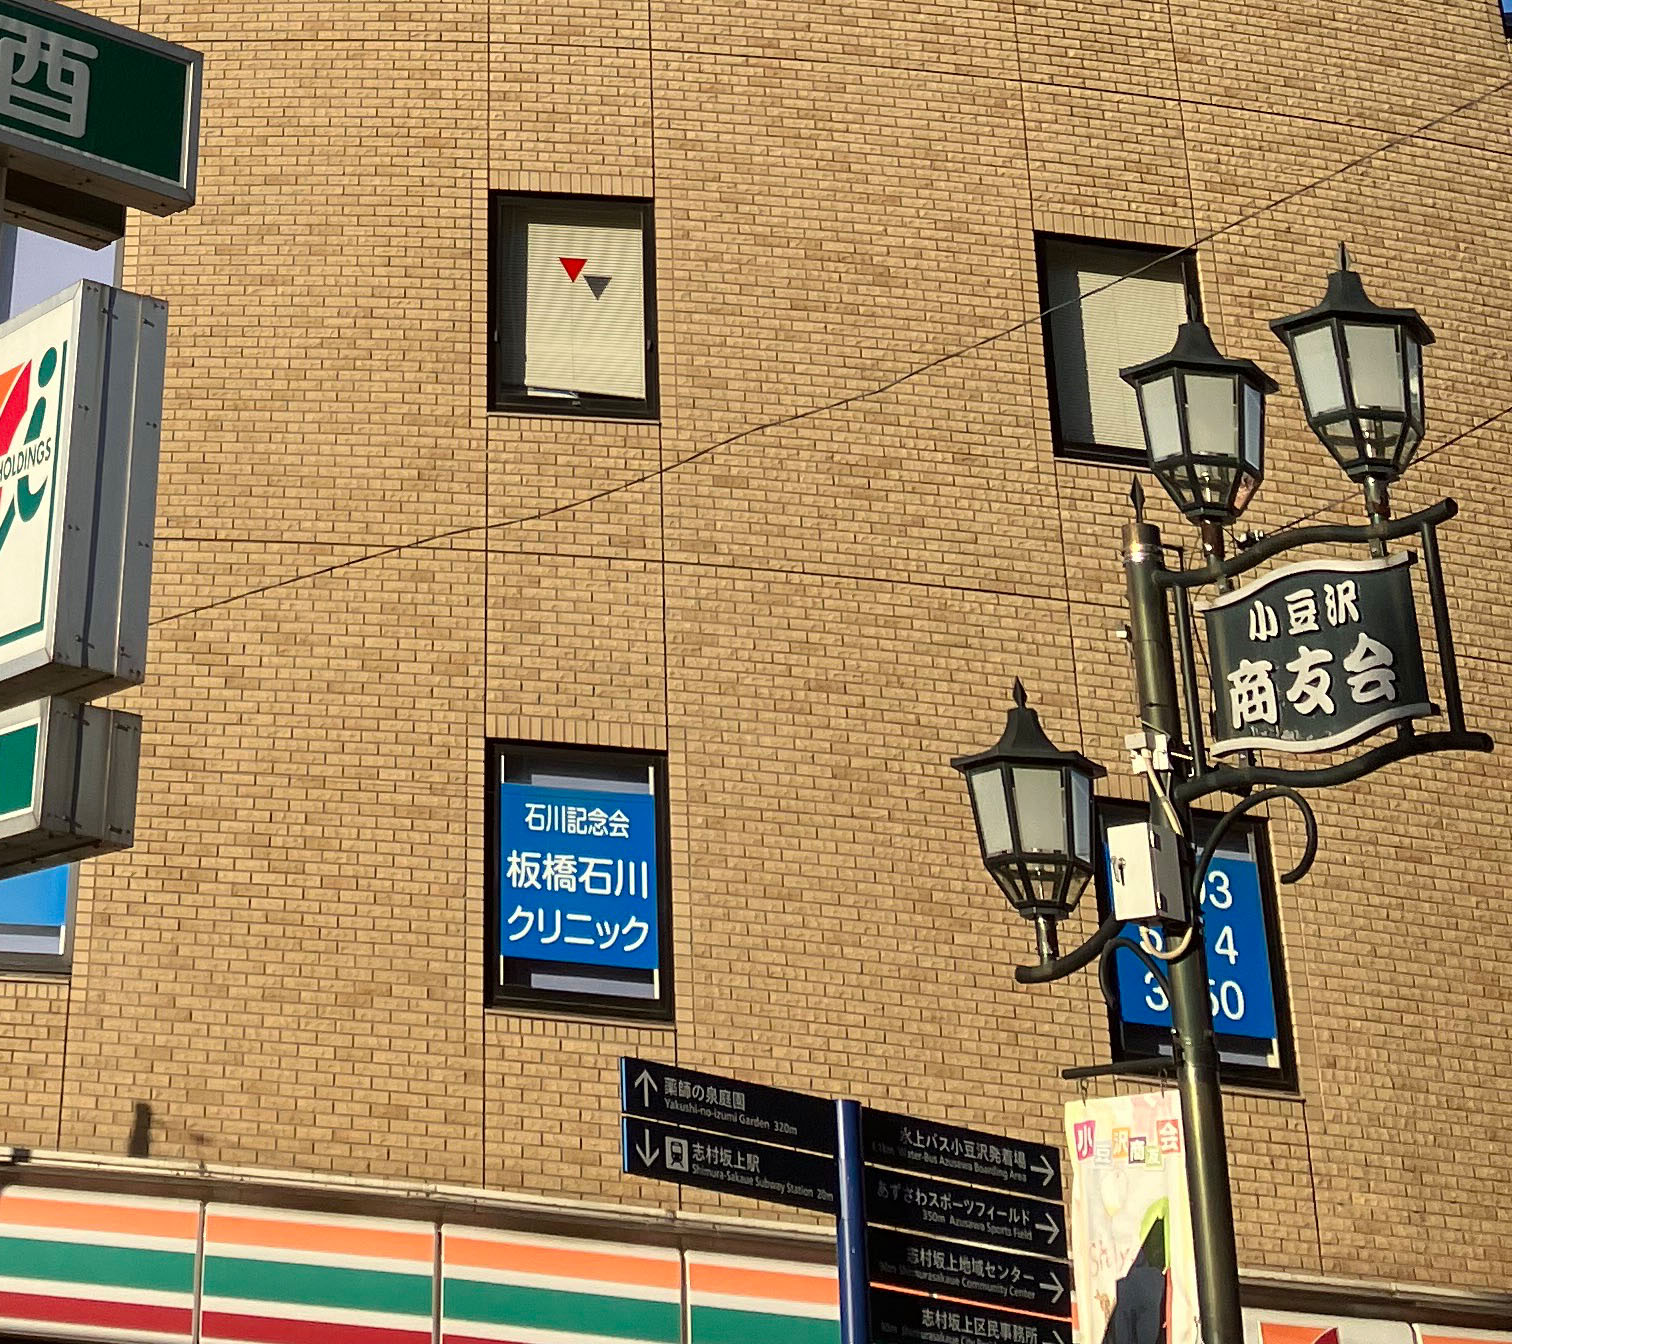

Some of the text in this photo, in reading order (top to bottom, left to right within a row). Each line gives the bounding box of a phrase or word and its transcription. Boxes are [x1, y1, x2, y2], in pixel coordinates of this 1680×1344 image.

[1249, 580, 1359, 641] 小豆沢
[1227, 632, 1396, 729] 商友会
[524, 803, 630, 838] 石川記念会
[506, 849, 648, 899] 板橋石川
[507, 905, 649, 952] クリニック
[664, 1077, 746, 1111] 薬師の泉庭園
[739, 1113, 770, 1130] Garden
[774, 1120, 798, 1135] 320m
[692, 1142, 760, 1174] 志村坂上駅
[1010, 1168, 1027, 1182] Area
[755, 1175, 785, 1194] Subway
[787, 1182, 814, 1198] Station
[877, 1180, 1031, 1226] あずさわスポーツフィールド
[986, 1221, 1012, 1237] Sports
[1013, 1226, 1032, 1241] Field
[907, 1247, 1035, 1283] 志村坂上地域センター
[962, 1277, 1008, 1297] Community
[1010, 1285, 1036, 1300] Center
